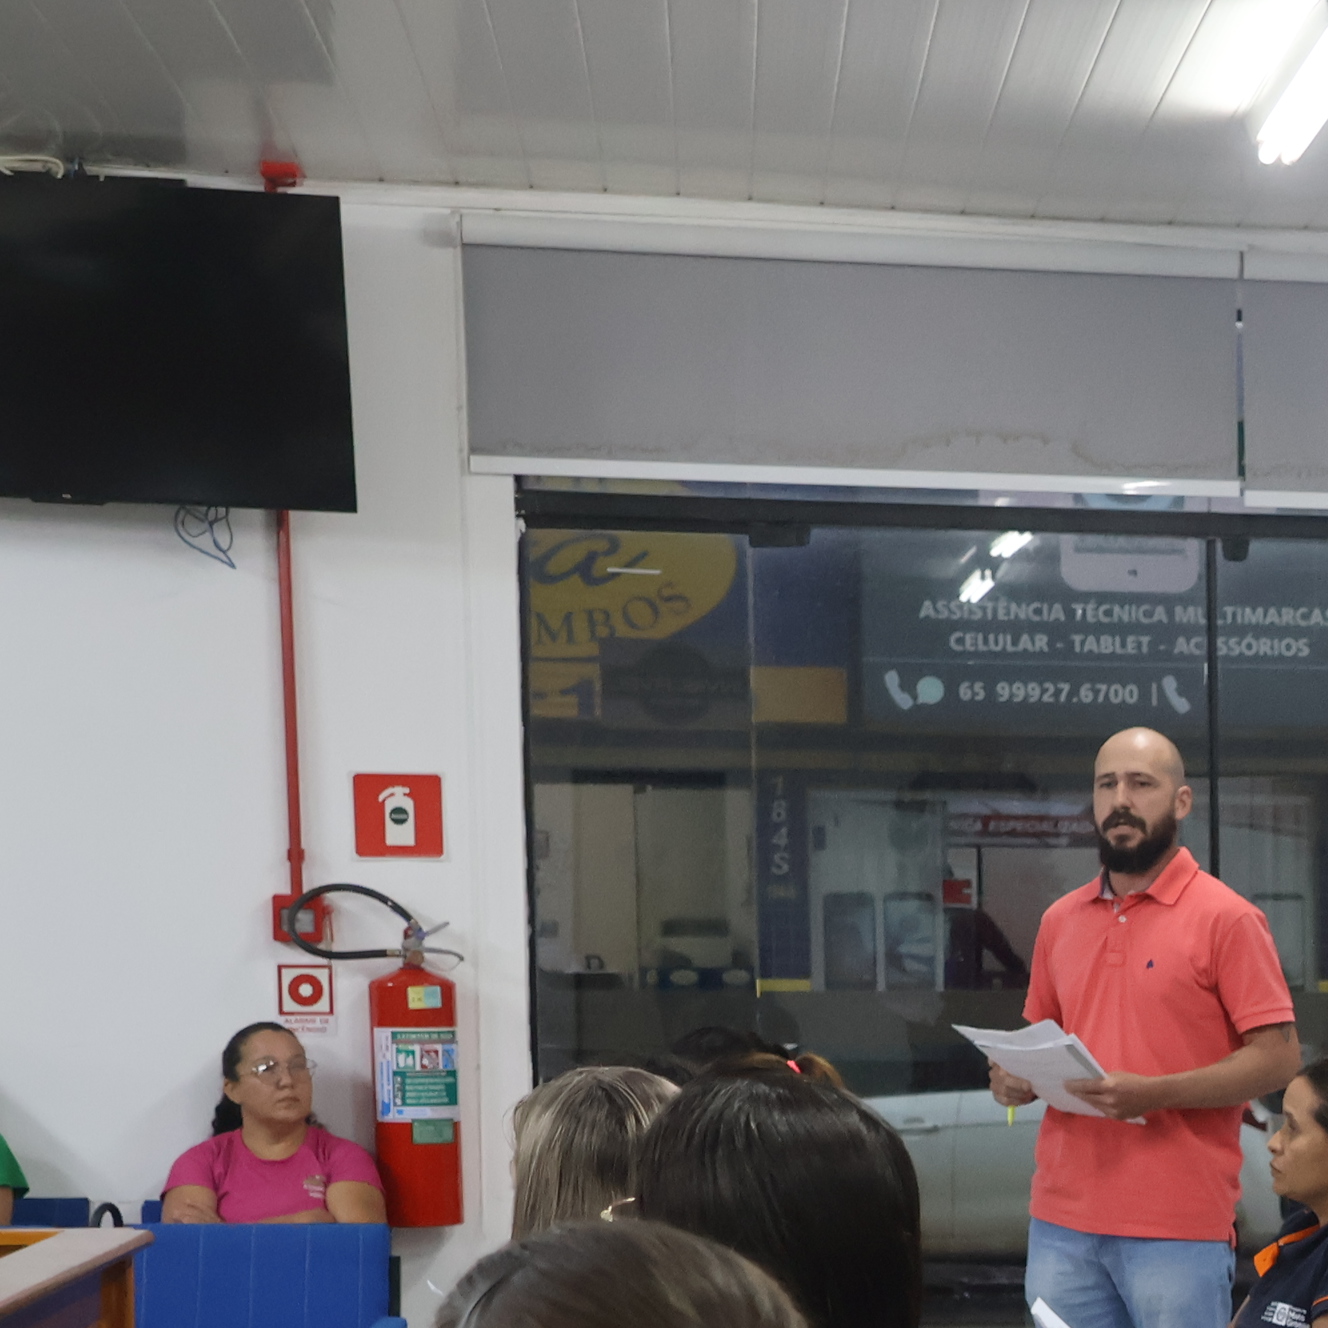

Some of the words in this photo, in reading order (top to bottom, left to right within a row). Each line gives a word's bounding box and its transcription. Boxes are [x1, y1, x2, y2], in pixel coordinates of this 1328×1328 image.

[1071, 599, 1168, 624] TÉCNICA
[949, 631, 1049, 652] CELULAR
[1070, 633, 1151, 655] TABLET
[1174, 633, 1311, 657] ACSSÓRIOS
[958, 681, 986, 701] 65
